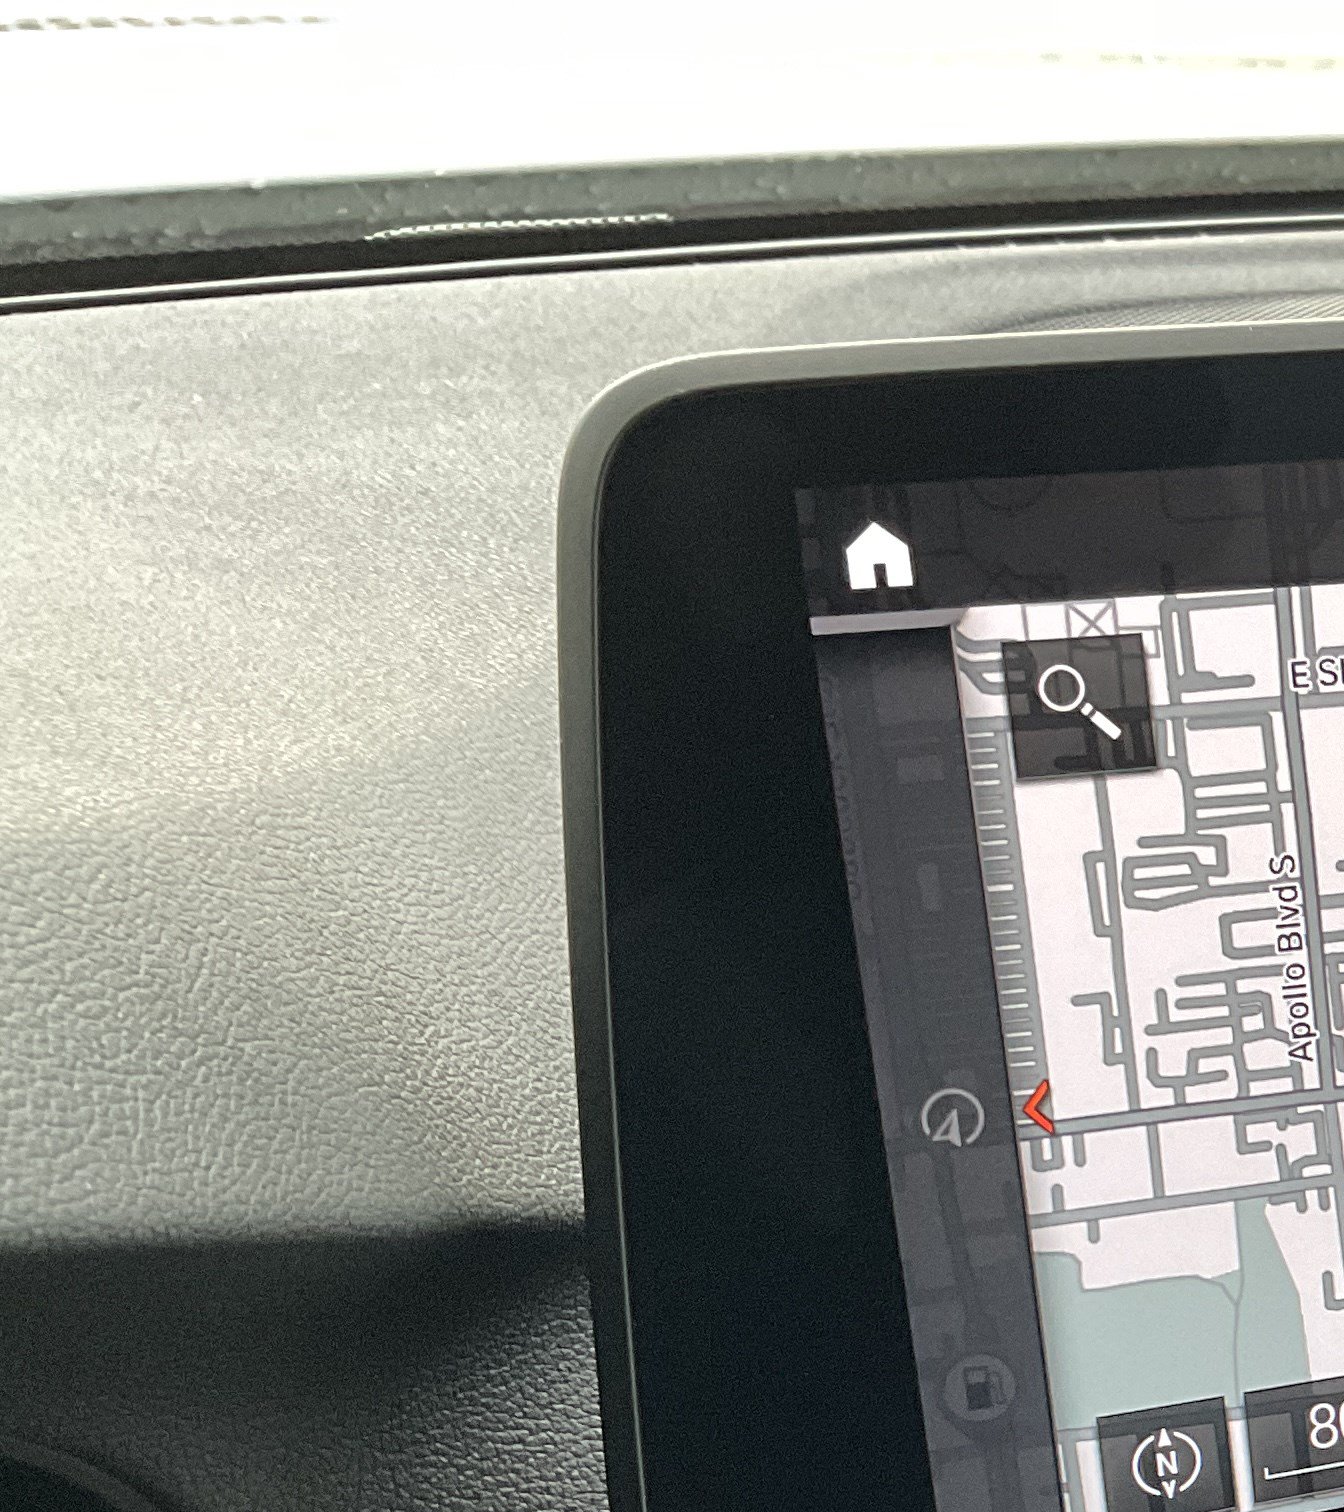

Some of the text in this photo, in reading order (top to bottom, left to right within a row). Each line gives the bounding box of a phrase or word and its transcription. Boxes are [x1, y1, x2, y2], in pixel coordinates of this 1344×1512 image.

[1291, 660, 1309, 688] E
[1270, 854, 1316, 1061] Apollo Blvd S
[1156, 1451, 1178, 1477] N
